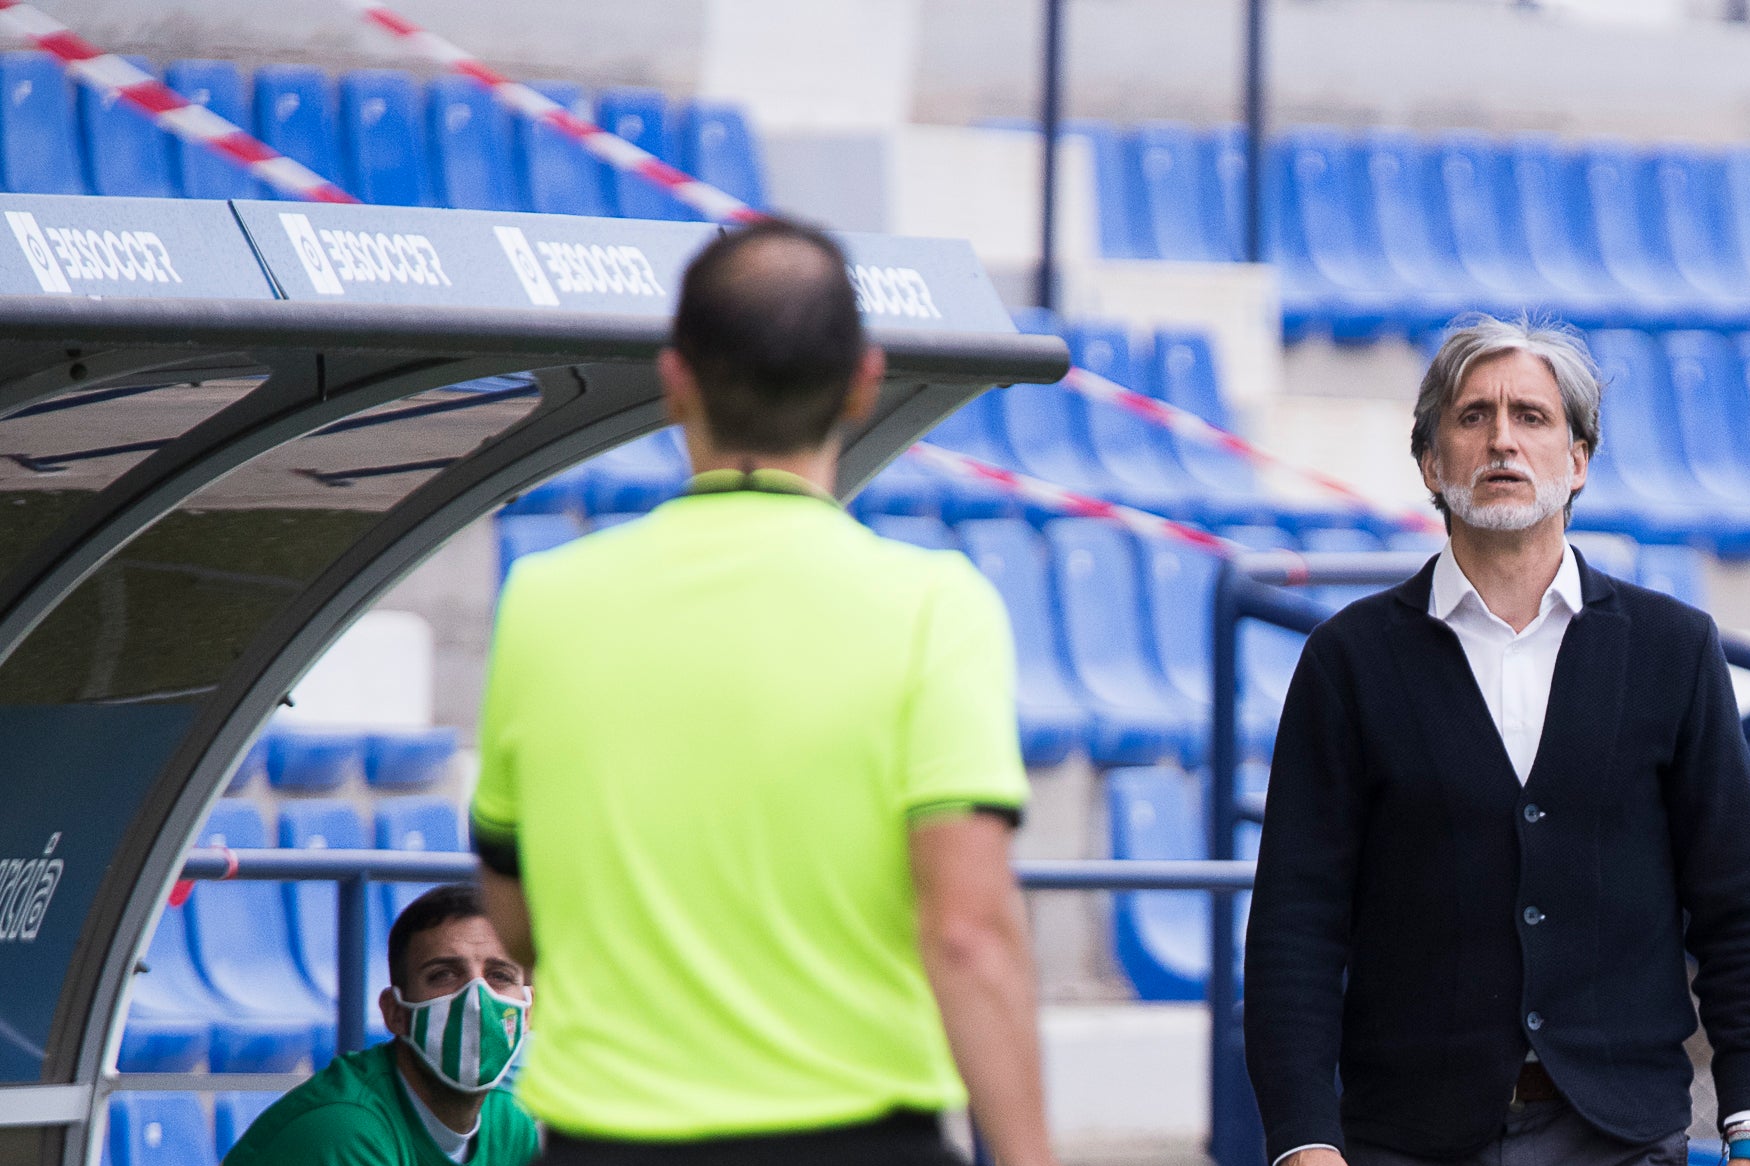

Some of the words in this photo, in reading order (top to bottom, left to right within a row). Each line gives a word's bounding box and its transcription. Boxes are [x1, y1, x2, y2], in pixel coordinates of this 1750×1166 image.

[46, 227, 183, 284] BESOCCER
[319, 228, 453, 286] BESOCCER
[536, 241, 667, 297] BESOCCER
[846, 263, 943, 320] SOCCER
